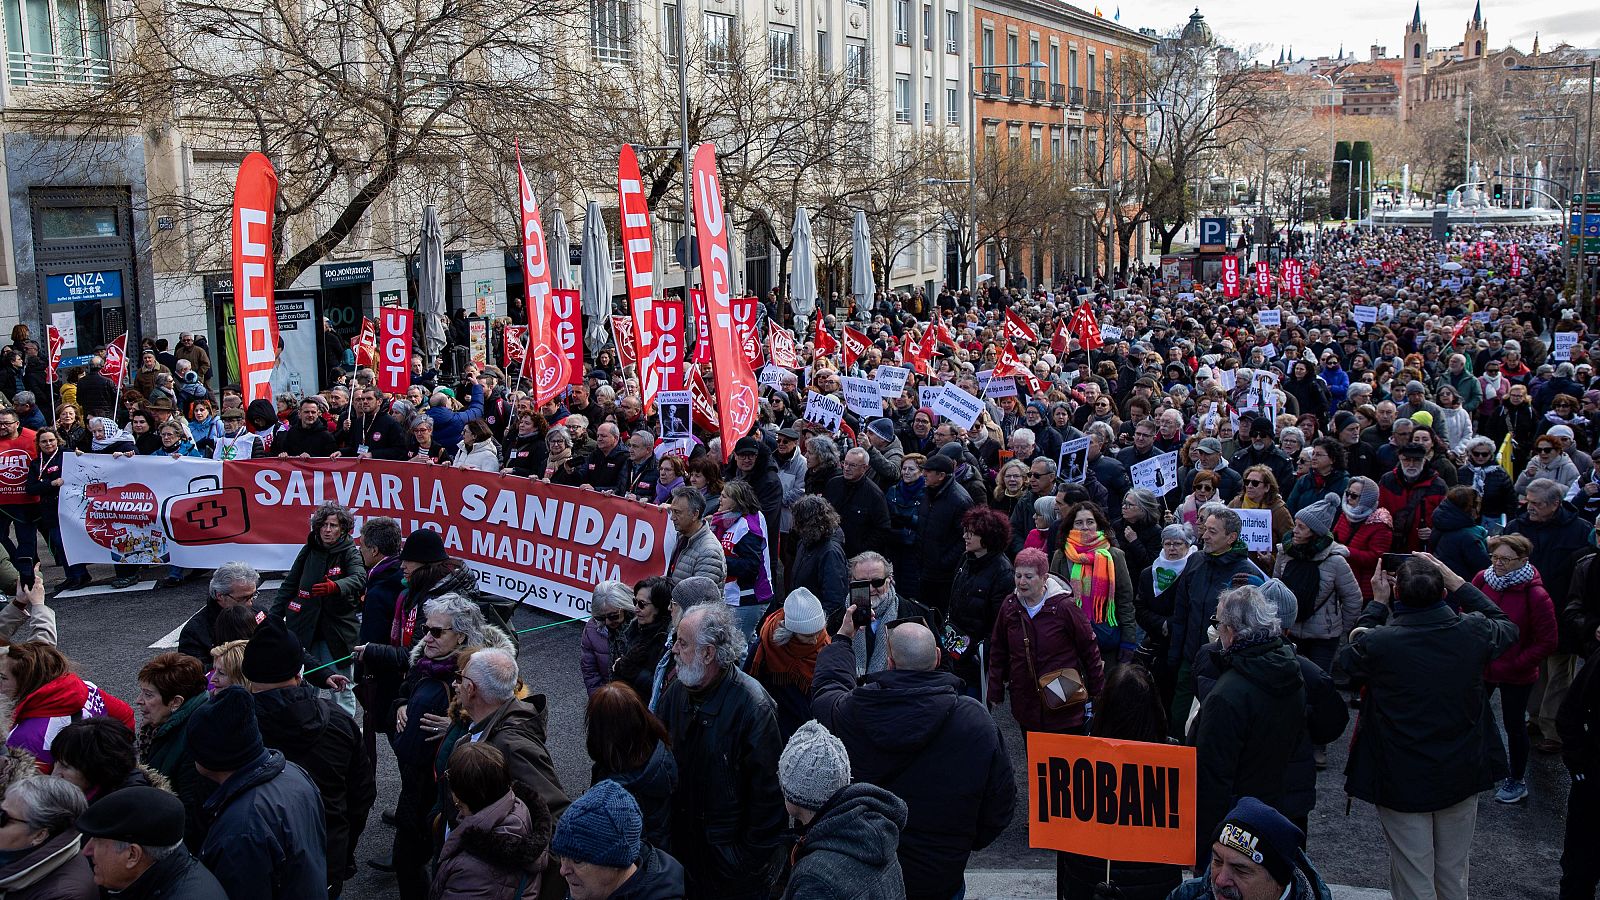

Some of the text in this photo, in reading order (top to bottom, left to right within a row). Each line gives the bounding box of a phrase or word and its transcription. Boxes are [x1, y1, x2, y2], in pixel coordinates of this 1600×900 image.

[1205, 221, 1220, 243] P
[64, 272, 105, 287] GINZA
[1225, 260, 1236, 294] UGT
[1257, 264, 1267, 293] UGT
[1293, 266, 1301, 294] UGT
[386, 313, 407, 387] UGT
[656, 307, 677, 391] UGT
[818, 394, 843, 415] SANIDAD
[938, 397, 946, 406] de
[944, 401, 953, 410] ser
[944, 388, 980, 413] Estamos cansados
[92, 501, 154, 512] SANIDAD
[120, 491, 145, 500] SALVAR
[89, 510, 118, 519] PÚBLICA
[254, 469, 655, 562] SALVAR LA SANIDAD
[1241, 518, 1268, 528] nitarios!
[471, 529, 622, 585] MADRILEÑA
[474, 568, 491, 584] DE
[496, 575, 548, 599] TODAS
[552, 590, 564, 603] Y
[1037, 757, 1180, 829] ¡ROBAN!
[1220, 823, 1259, 851] REAL
